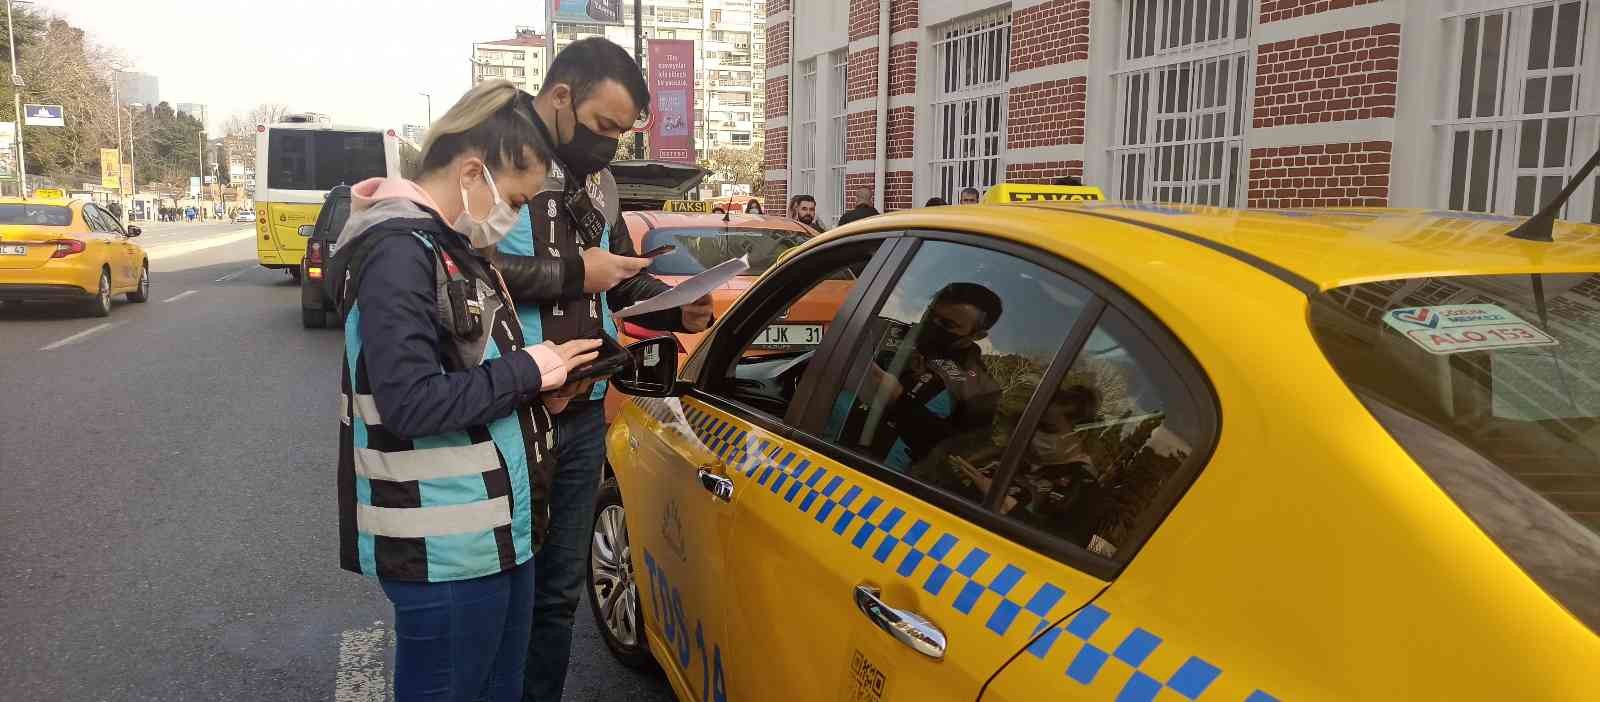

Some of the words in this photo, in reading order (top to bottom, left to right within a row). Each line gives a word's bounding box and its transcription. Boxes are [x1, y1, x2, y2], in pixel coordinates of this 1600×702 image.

[764, 327, 789, 343] TJK
[805, 327, 820, 343] 31
[1430, 330, 1488, 346] ALO
[1488, 327, 1535, 342] 153
